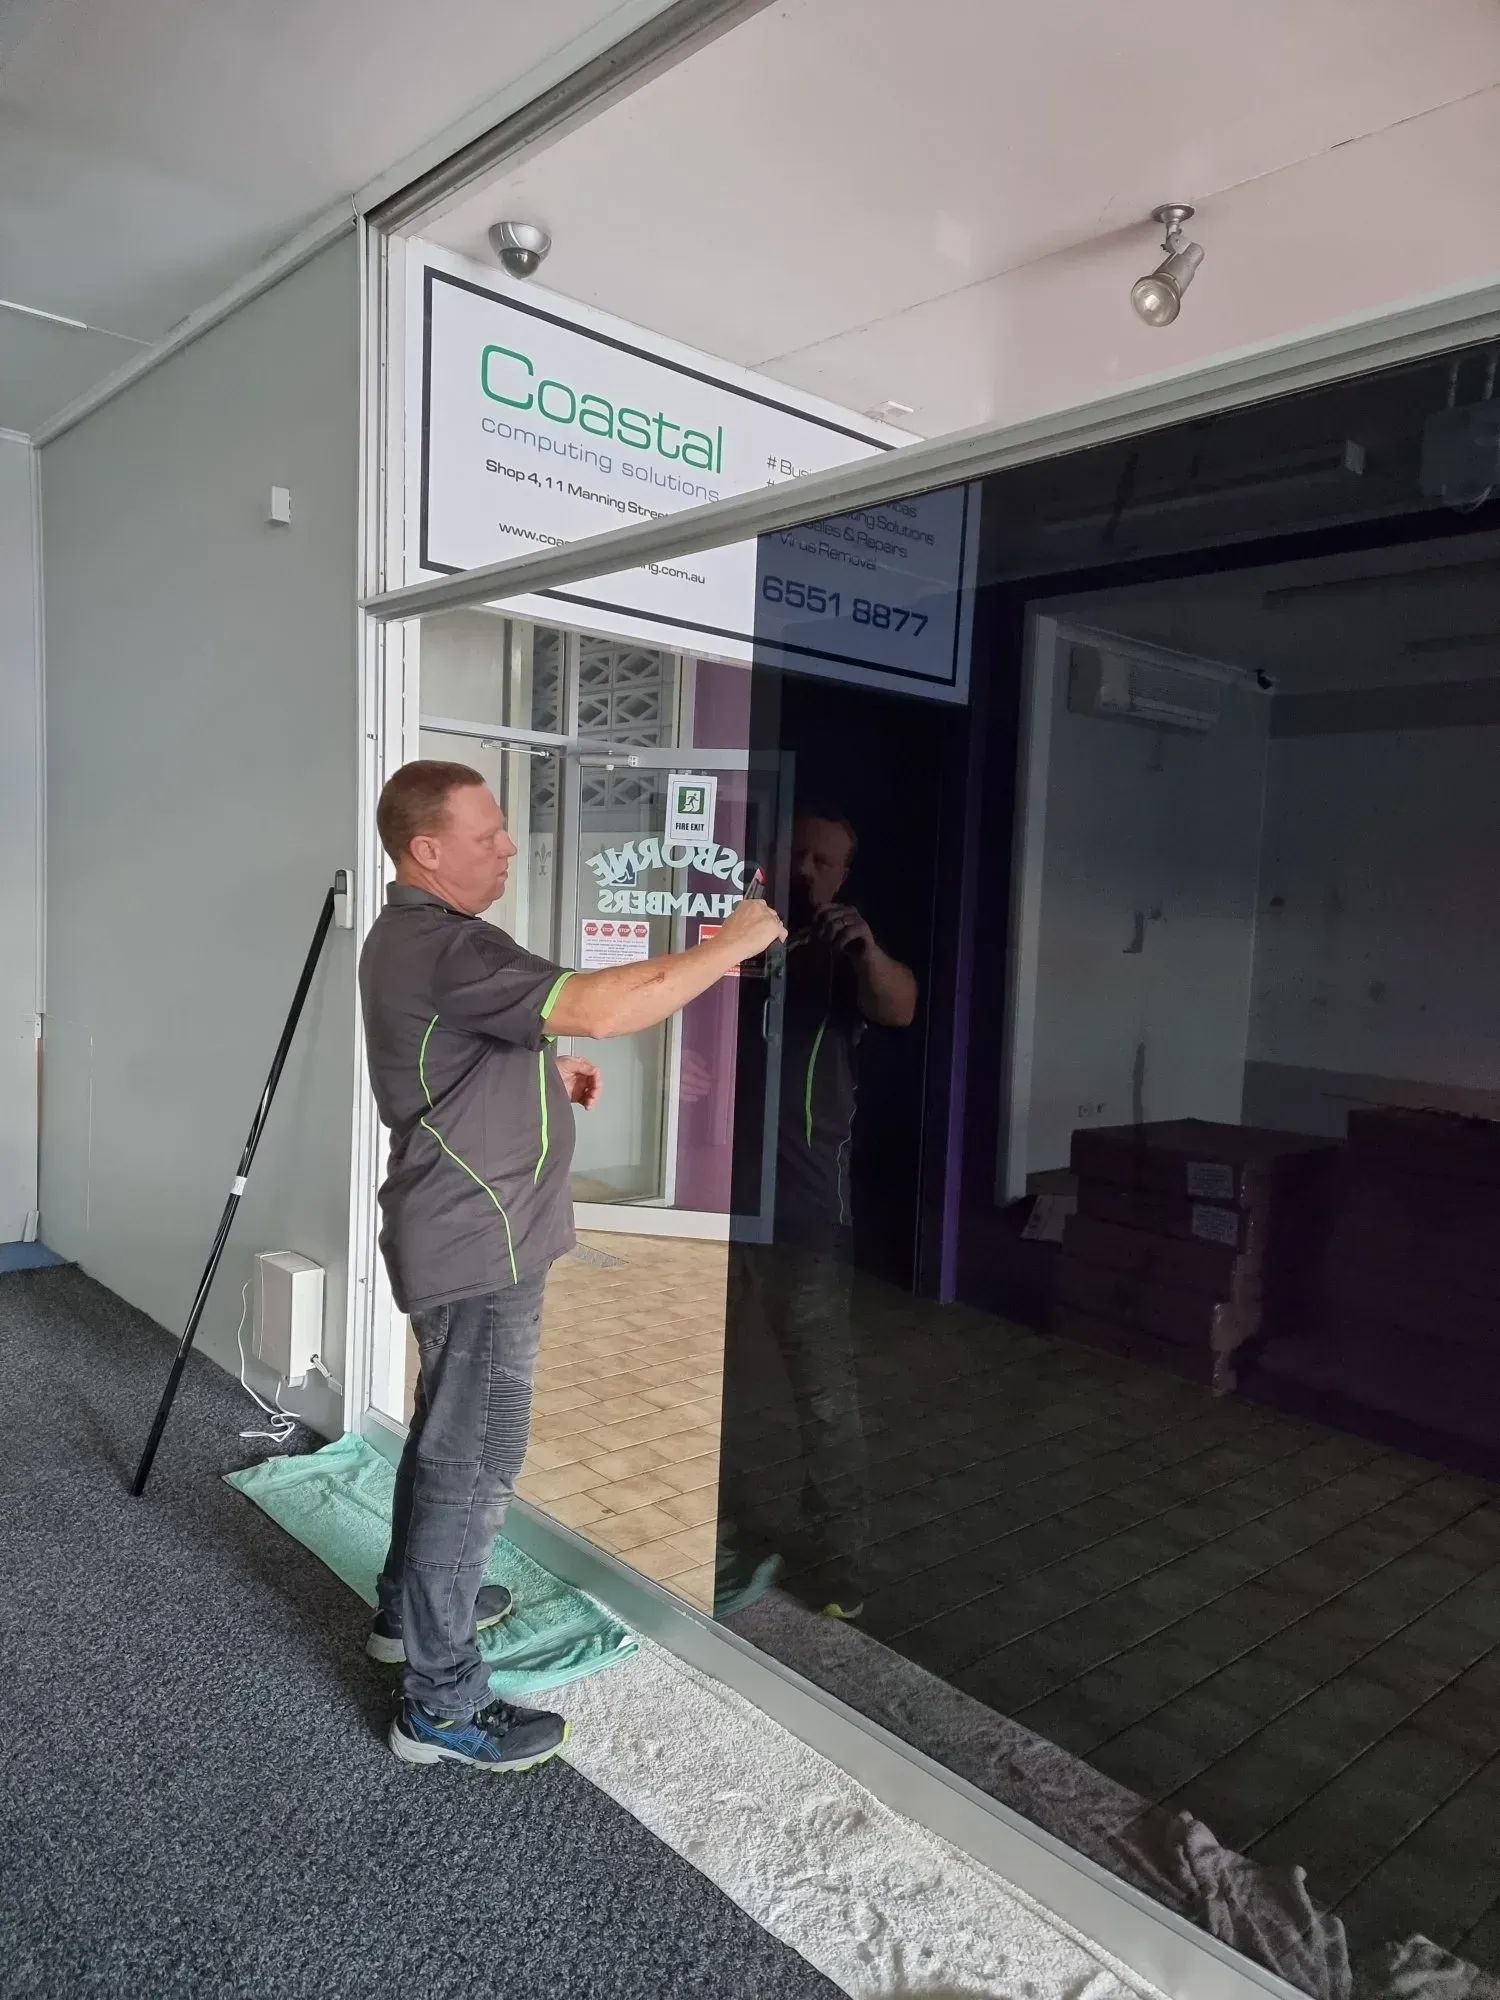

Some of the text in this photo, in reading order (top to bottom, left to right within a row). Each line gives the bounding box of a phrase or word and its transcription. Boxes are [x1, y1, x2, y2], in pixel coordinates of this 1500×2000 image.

[481, 344, 723, 474] Coastal
[481, 417, 720, 503] computing solutions
[486, 459, 525, 482] Shop
[567, 483, 626, 513] Manning
[780, 532, 877, 571] Virus Removal
[843, 527, 855, 542] &
[857, 531, 908, 558] Repairs
[877, 515, 935, 547] Solutions
[762, 575, 929, 637] 6551 8877
[675, 822, 704, 832] FIRE EXIT
